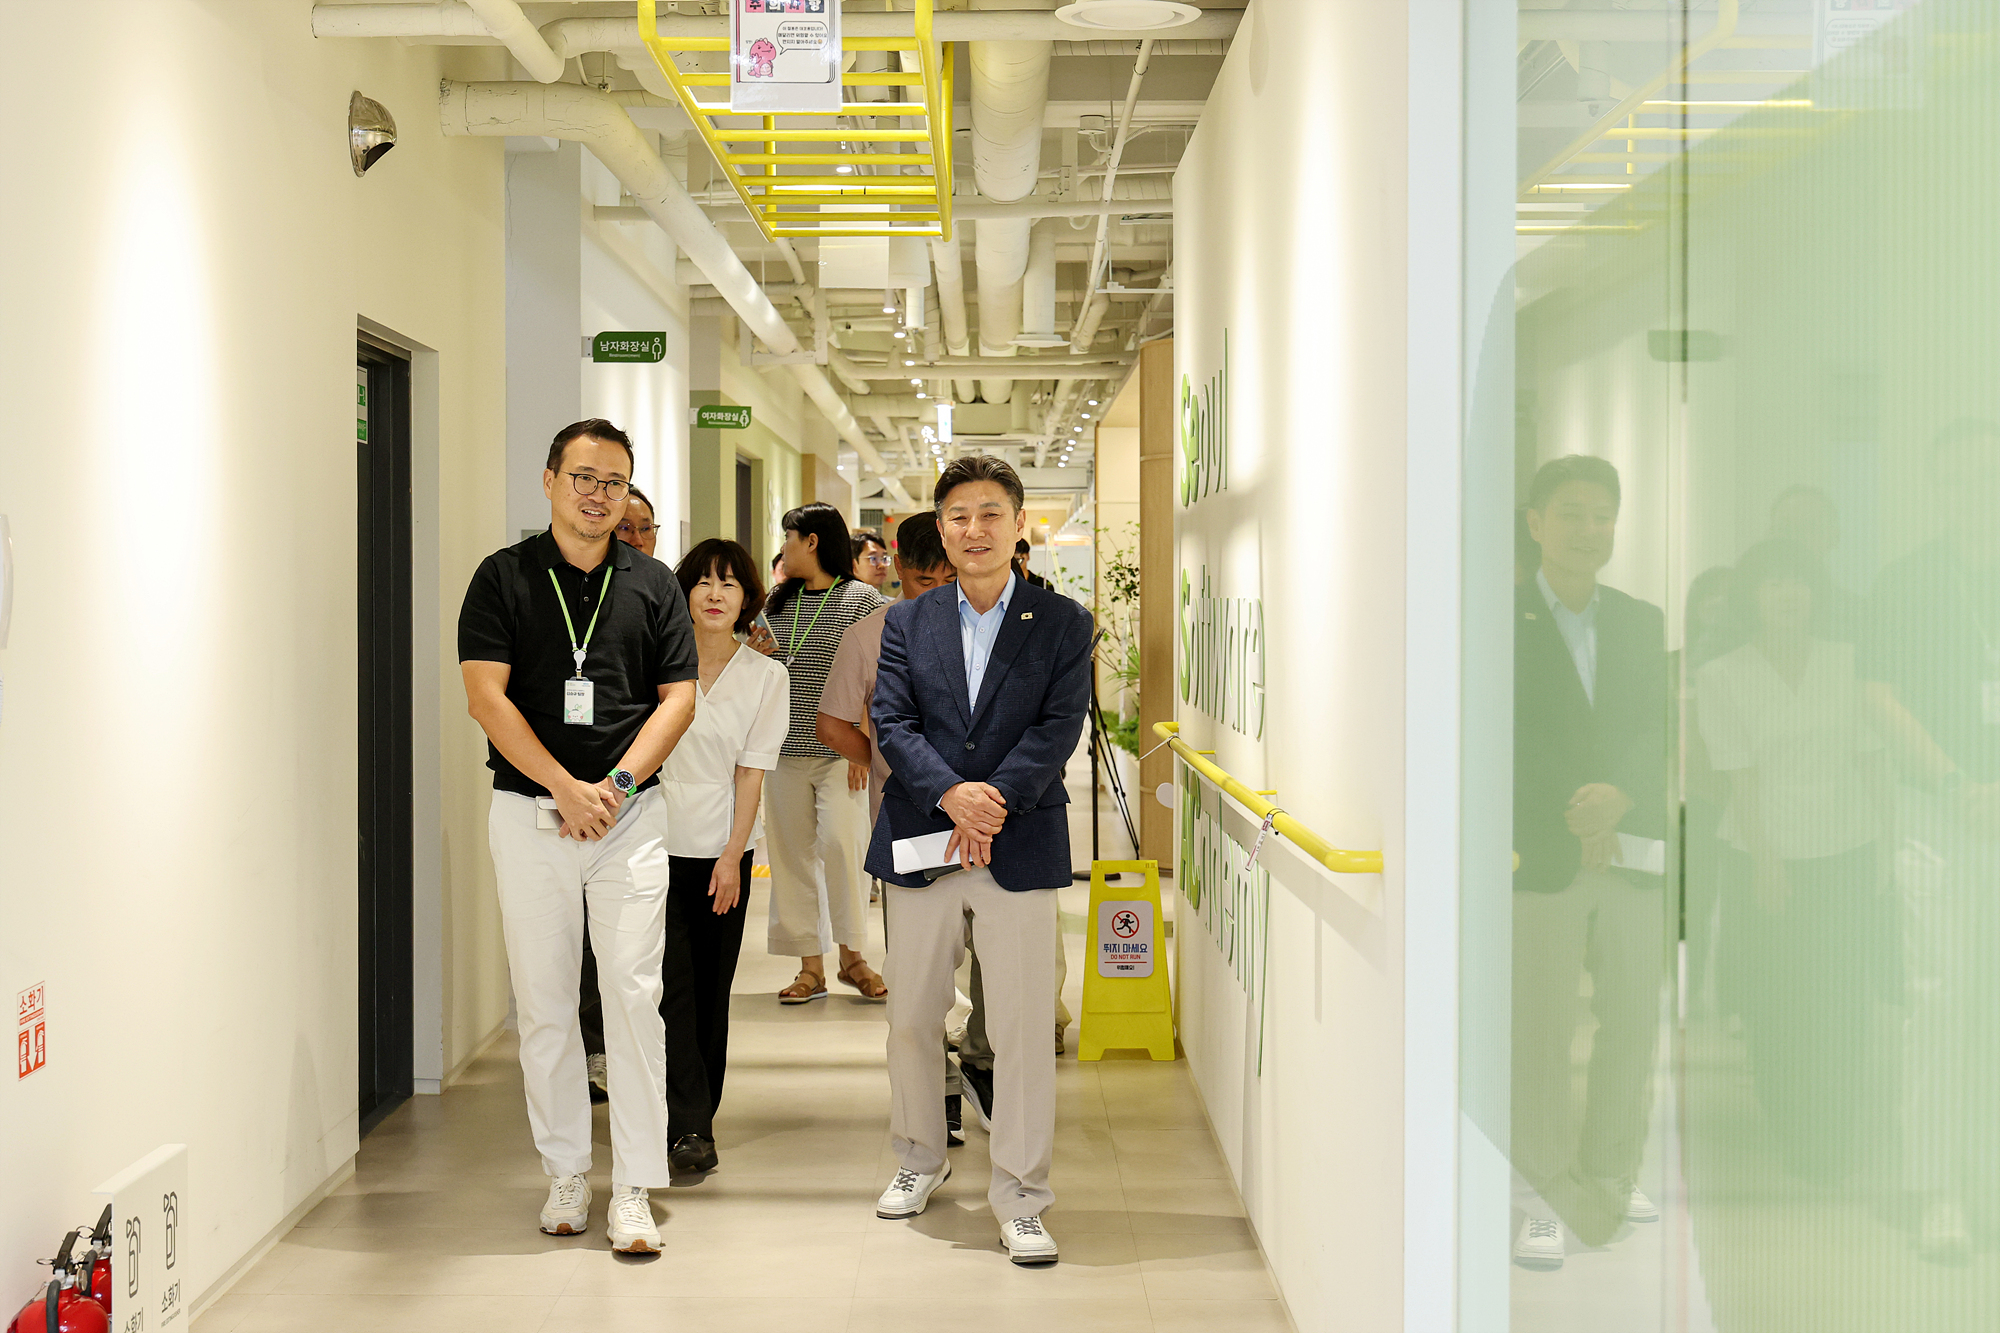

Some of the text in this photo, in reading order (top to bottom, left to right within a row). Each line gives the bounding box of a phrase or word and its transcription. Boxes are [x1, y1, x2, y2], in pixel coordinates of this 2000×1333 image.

[600, 341, 650, 352] 남자화장실
[701, 412, 739, 421] 여자화장실
[1180, 328, 1227, 509] Seoul
[1180, 565, 1265, 742] Software
[1179, 763, 1270, 1077] Academy
[1103, 943, 1148, 953] 뛰지 마세요
[19, 985, 44, 1015] 소화기
[161, 1278, 180, 1313] 소화기
